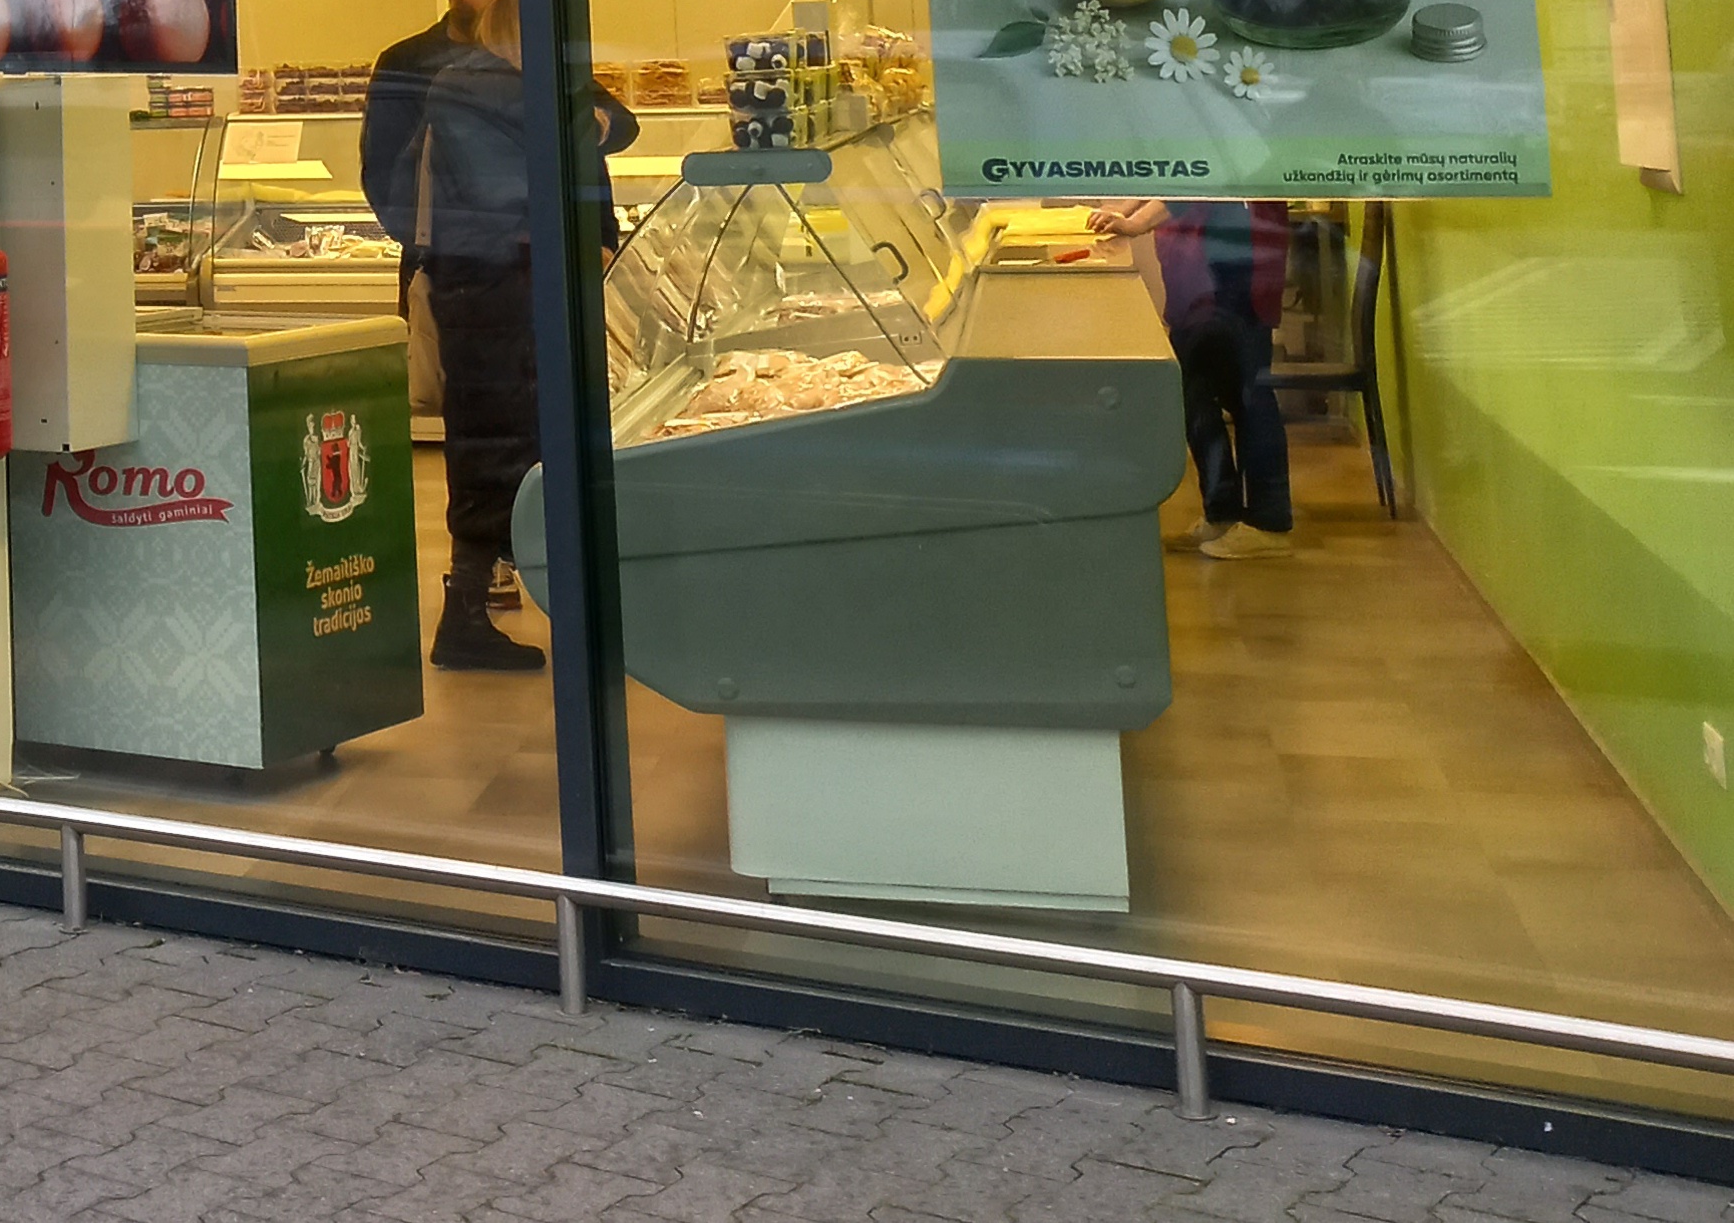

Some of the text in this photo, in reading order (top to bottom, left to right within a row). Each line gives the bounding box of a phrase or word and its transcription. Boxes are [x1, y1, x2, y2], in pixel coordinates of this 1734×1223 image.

[981, 156, 1211, 183] GYVASMAISTAS
[1337, 151, 1517, 168] Atraskite mūsų naturalių
[1283, 168, 1519, 185] užkandžių ir gėrimų asortimentą
[41, 448, 206, 518] Romo
[158, 504, 213, 523] gaminiai
[305, 553, 375, 589] Žemaitiško
[320, 579, 363, 609] skonio
[313, 605, 372, 637] tradicijos
